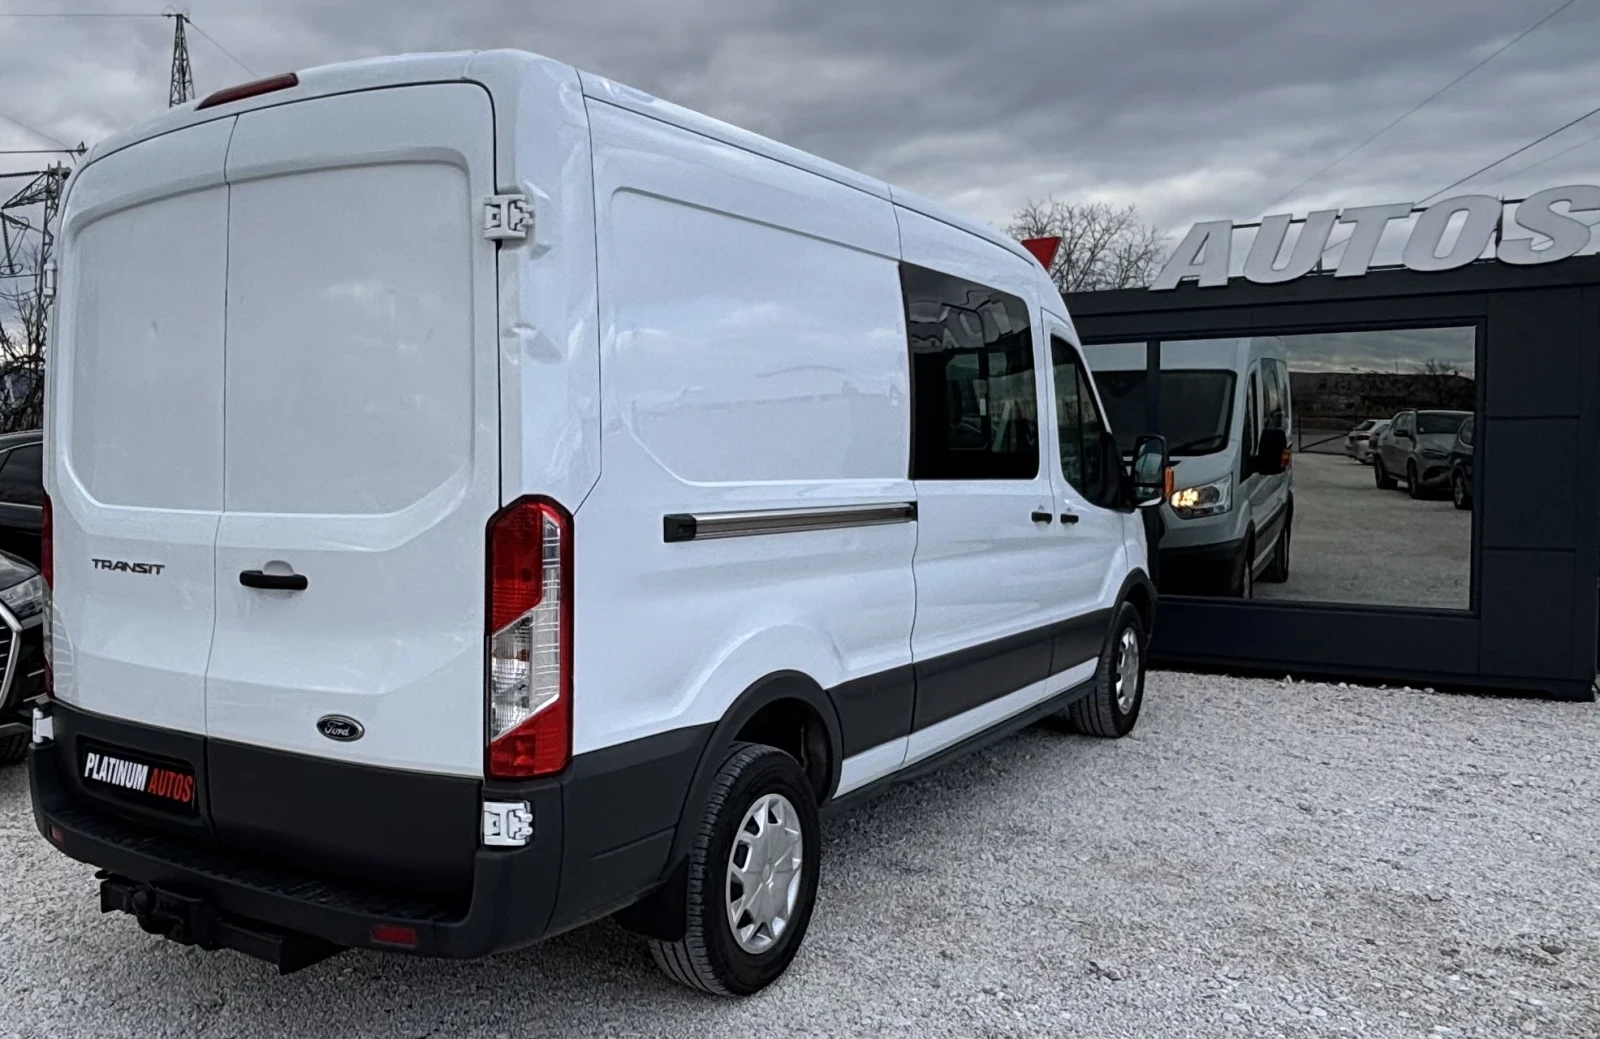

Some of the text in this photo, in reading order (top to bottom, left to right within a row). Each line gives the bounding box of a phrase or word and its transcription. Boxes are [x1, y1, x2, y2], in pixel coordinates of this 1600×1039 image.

[1148, 184, 1600, 291] AUTOS
[92, 558, 165, 576] TRANSIT
[324, 720, 351, 737] Ford
[84, 752, 194, 803] PLATINUM AUTOS
